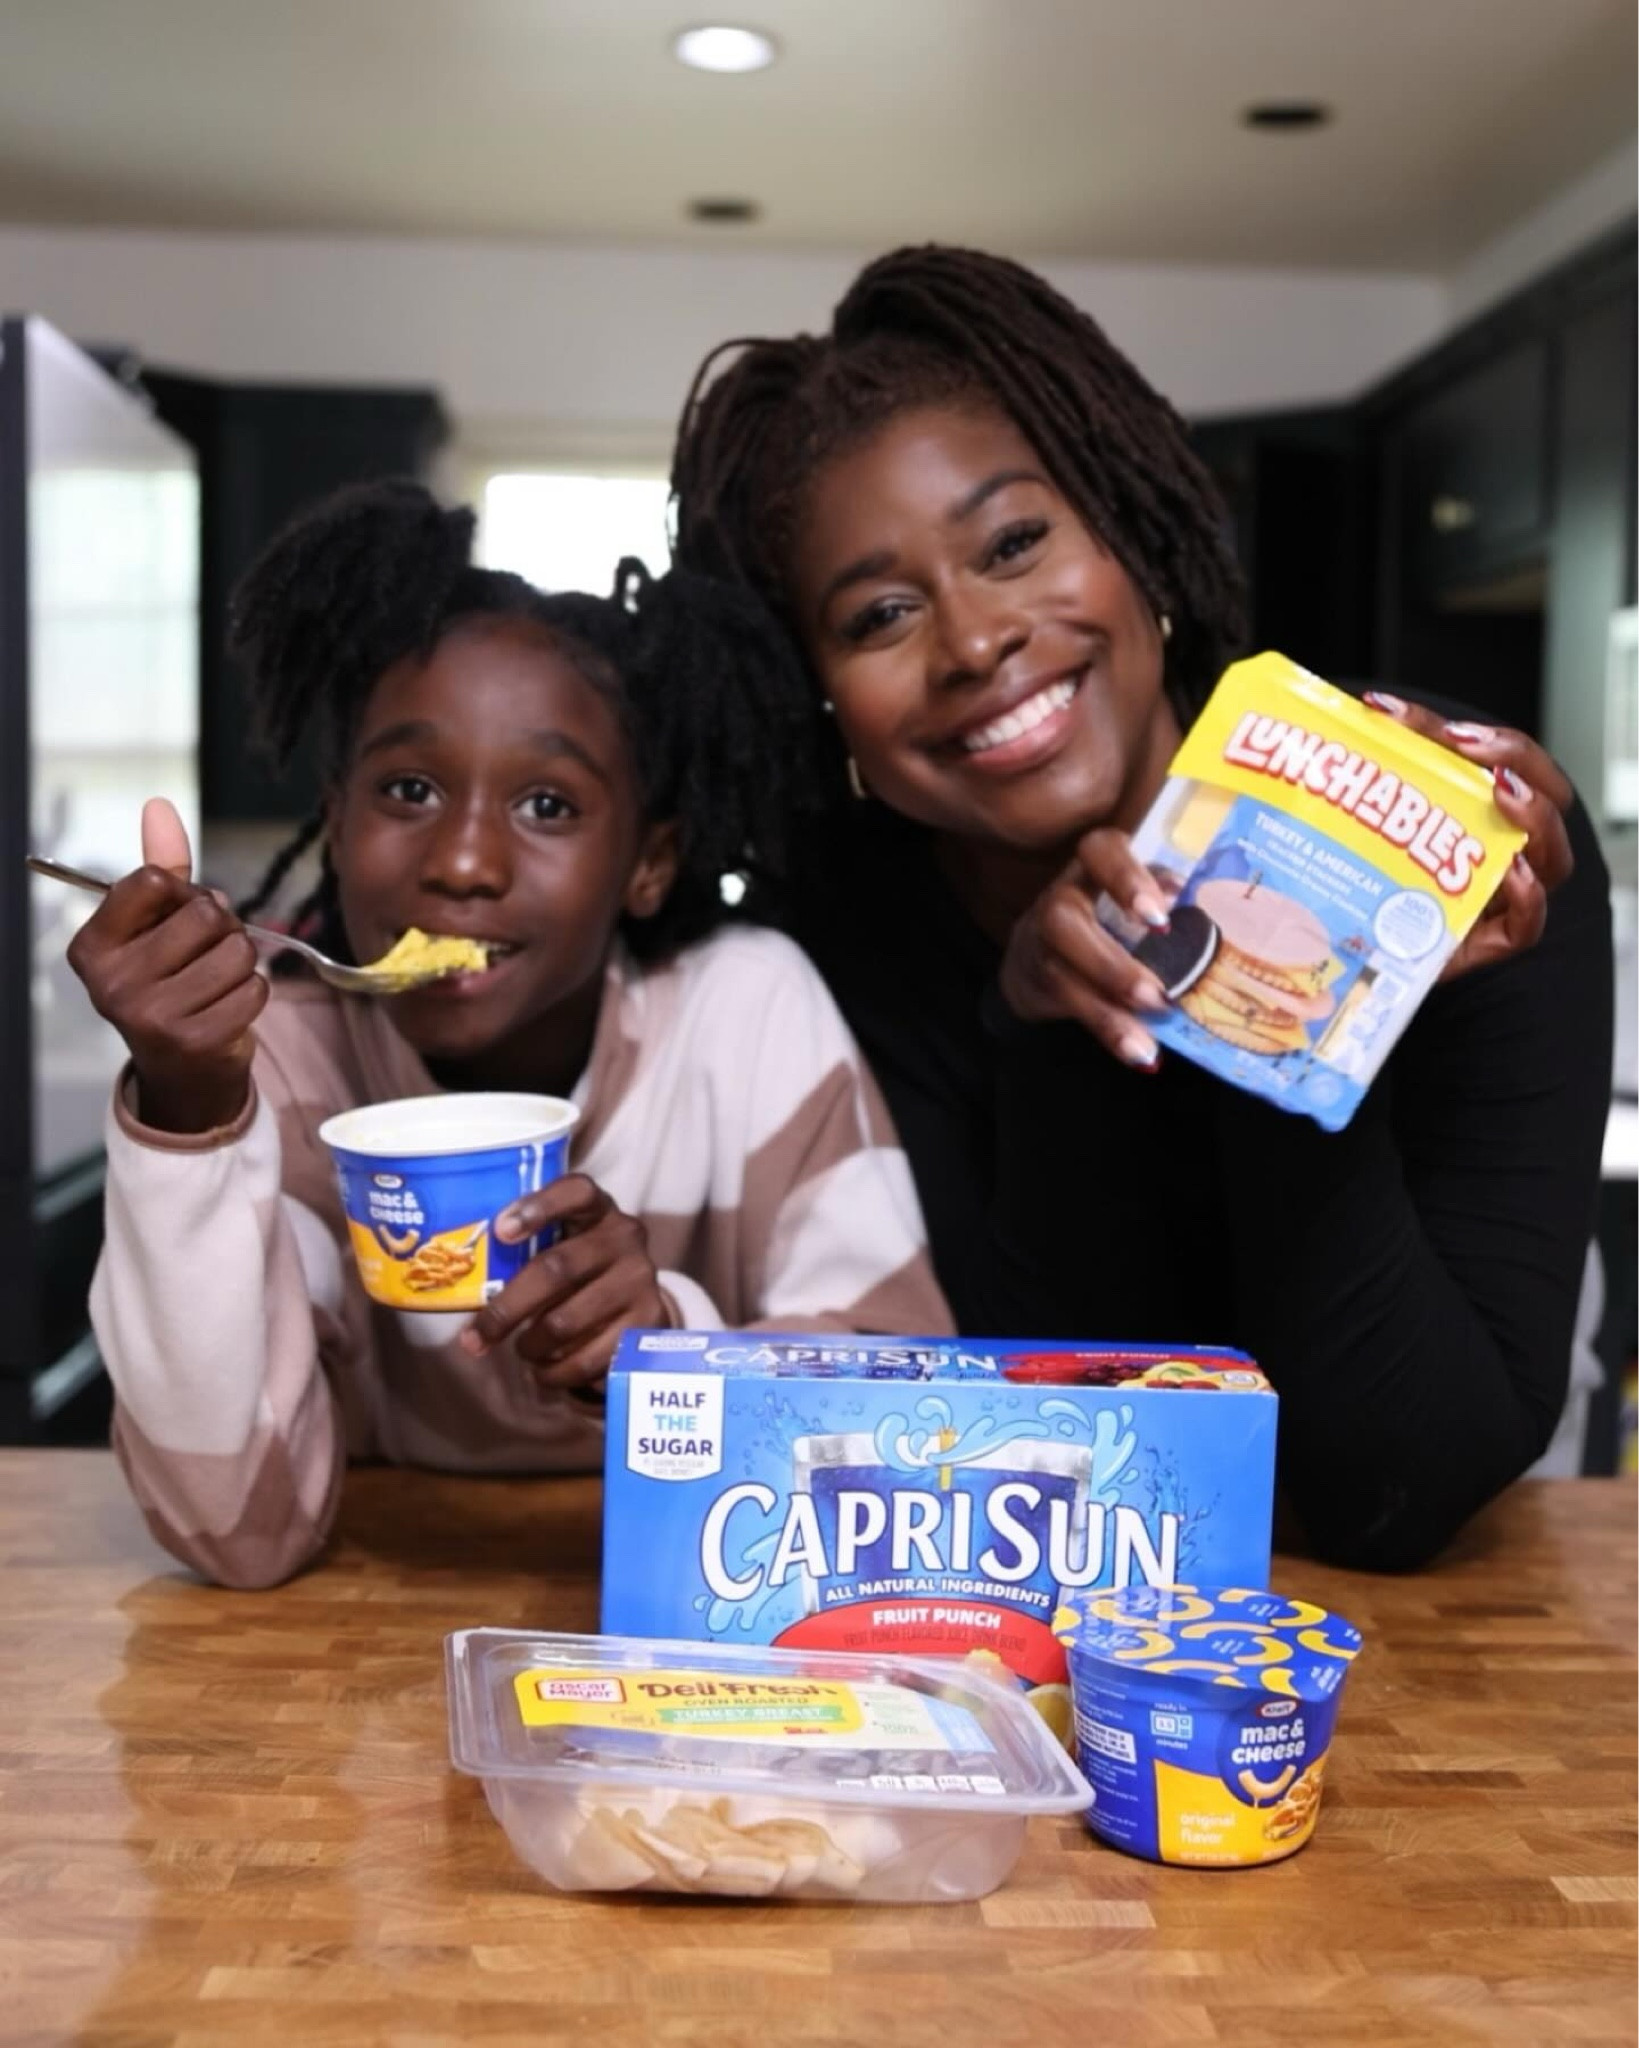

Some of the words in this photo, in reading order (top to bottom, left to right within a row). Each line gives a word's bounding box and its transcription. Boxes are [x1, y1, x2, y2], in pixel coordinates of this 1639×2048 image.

[1223, 711, 1487, 897] LUNCHABLES
[1255, 811, 1305, 847] TURKEY
[1313, 848, 1383, 896] AMERICAN
[649, 1390, 707, 1409] HALF
[653, 1413, 697, 1432] THE
[638, 1437, 713, 1456] SUGAR
[825, 1586, 855, 1602] ALL
[858, 1578, 935, 1595] NATURAL
[941, 1577, 1051, 1607] INGREDIENTS
[872, 1608, 928, 1626] FRUIT
[932, 1608, 1001, 1628] PUNCH
[637, 1682, 717, 1698] Deli
[719, 1682, 838, 1695] Fresh
[734, 1697, 808, 1705] ROASTED
[674, 1709, 746, 1720] TURKEY
[1180, 1811, 1236, 1830] original
[1180, 1827, 1223, 1844] flavor
